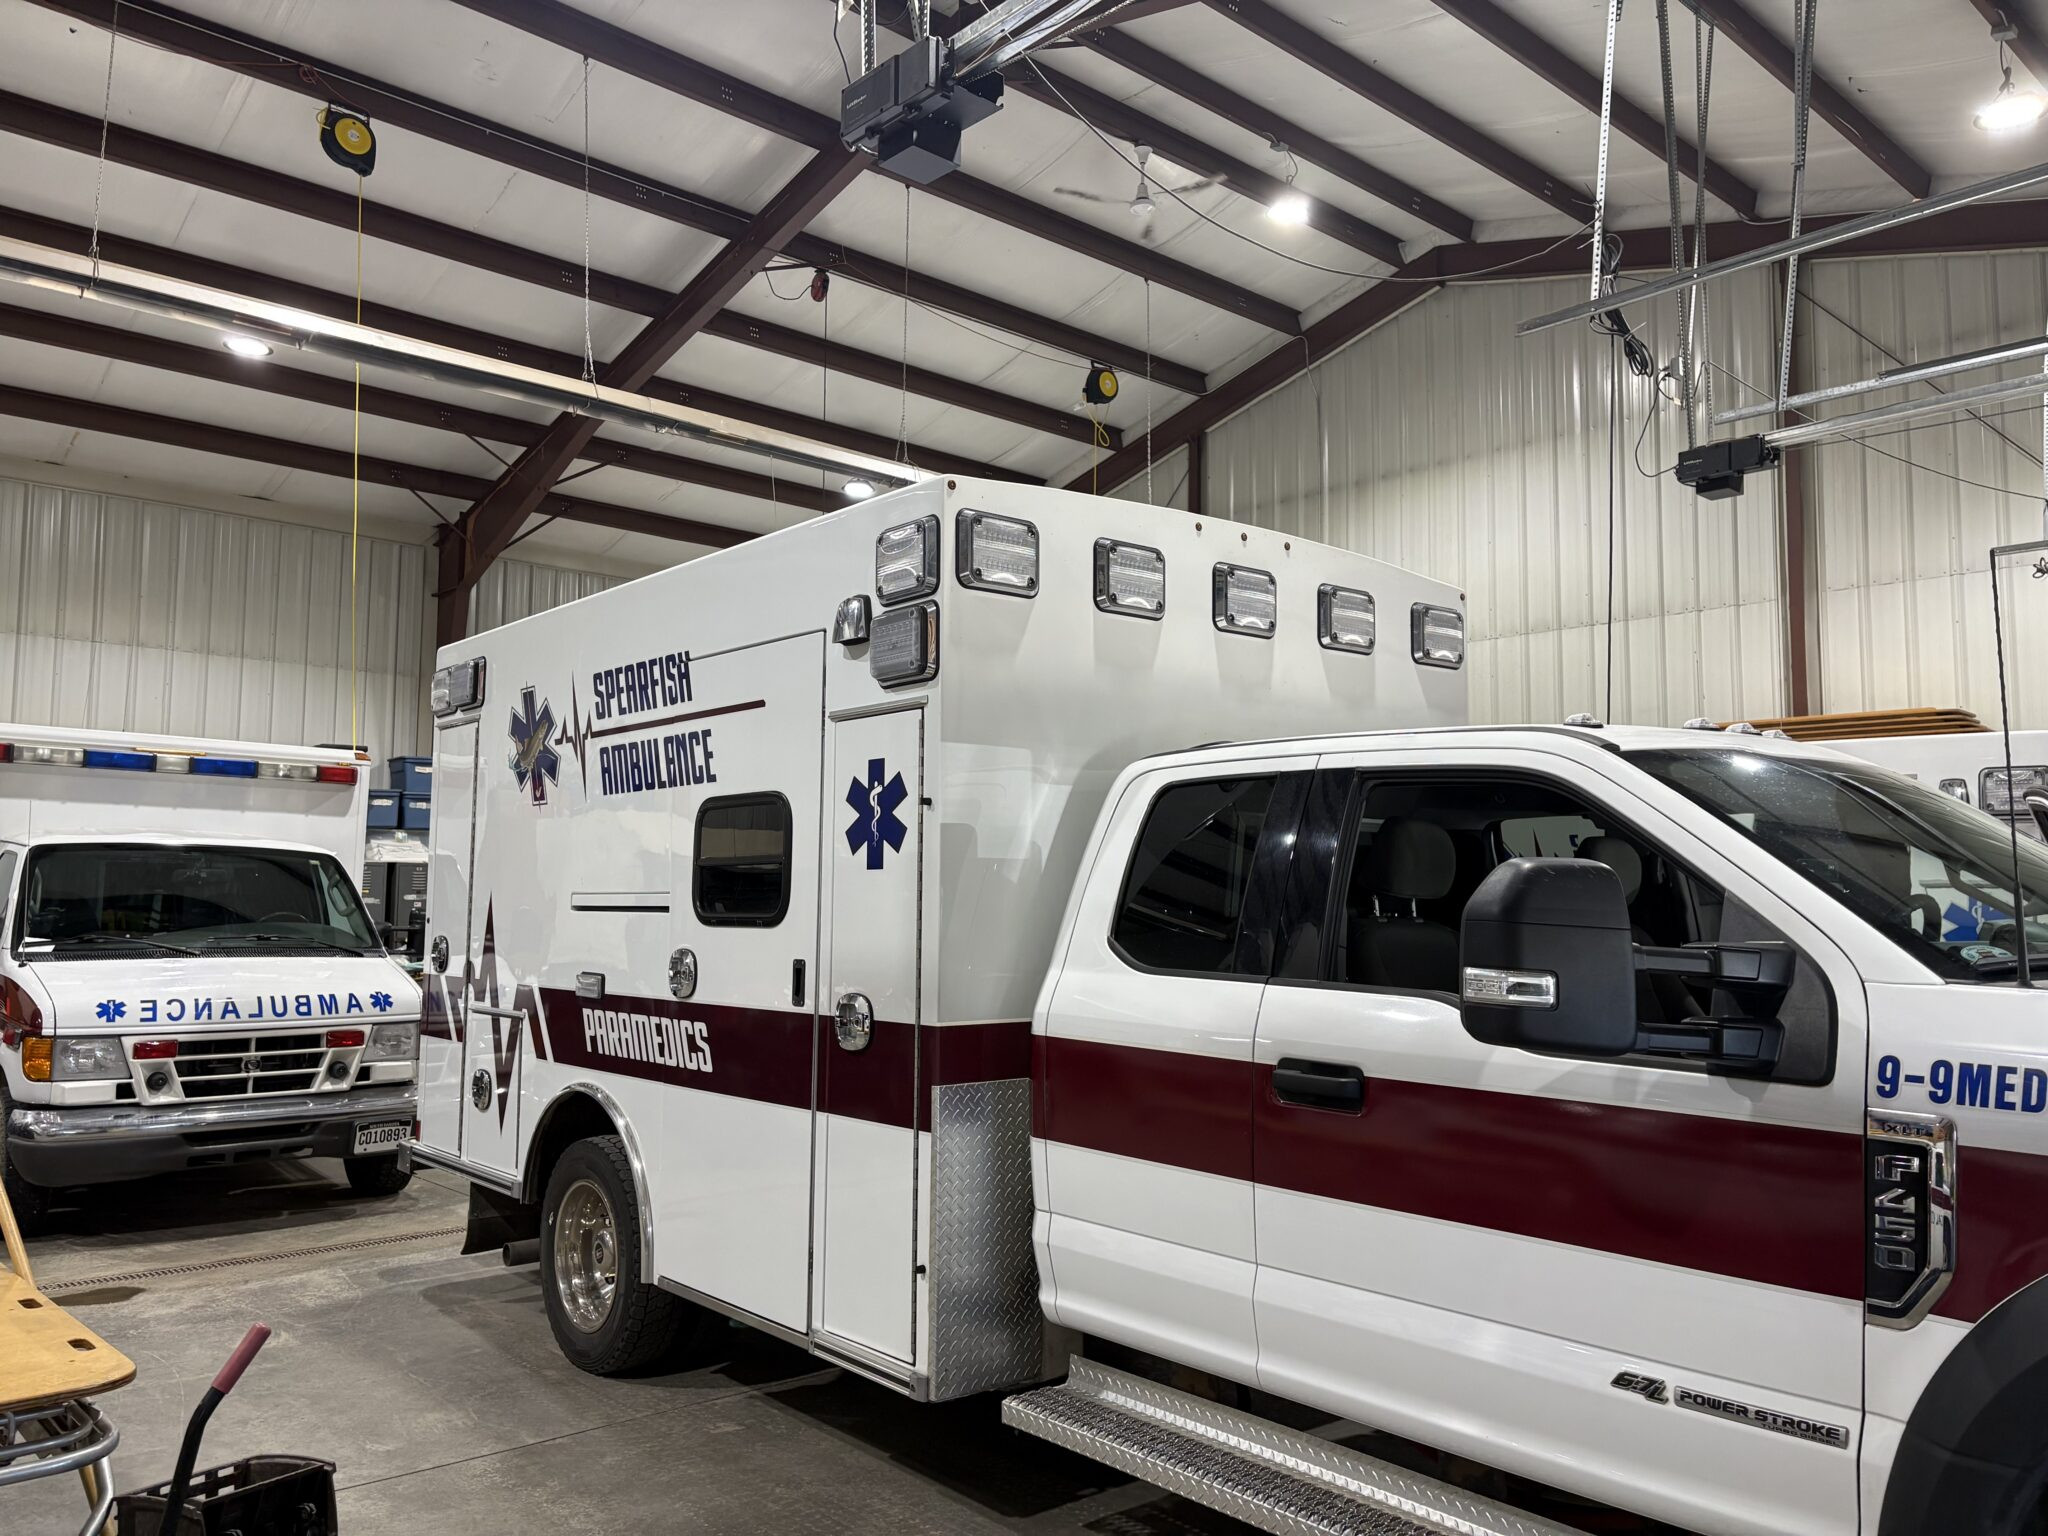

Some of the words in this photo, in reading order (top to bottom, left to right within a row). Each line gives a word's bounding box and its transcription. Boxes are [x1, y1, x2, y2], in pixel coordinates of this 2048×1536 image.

[593, 650, 692, 720] SPEARFISH
[600, 729, 717, 795] AMBULANCE
[582, 1008, 713, 1073] PARAMEDICS
[1876, 1055, 2048, 1113] 9-9MED
[1680, 1390, 1749, 1418] POWER
[1754, 1409, 1841, 1441] STROKE
